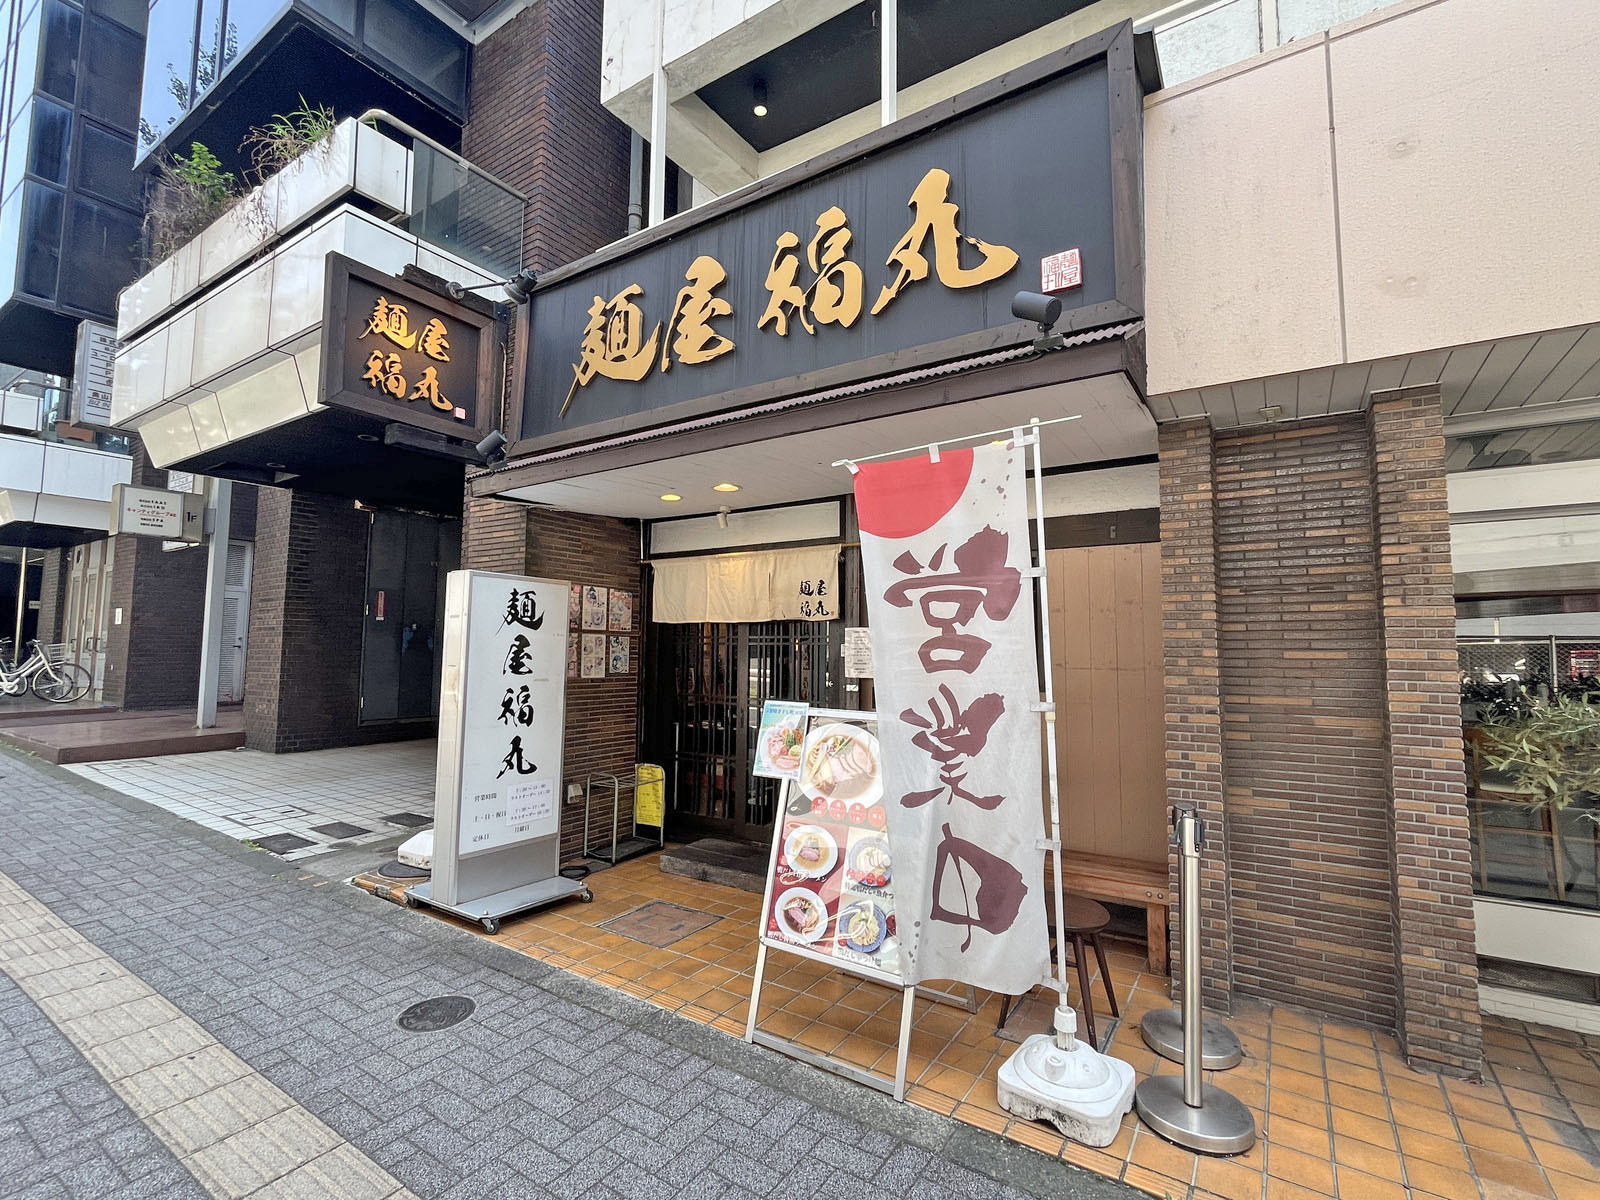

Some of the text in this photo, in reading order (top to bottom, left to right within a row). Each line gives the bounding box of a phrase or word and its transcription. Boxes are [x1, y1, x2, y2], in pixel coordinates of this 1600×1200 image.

[186, 511, 197, 522] 1F
[884, 524, 1028, 953] 営業中
